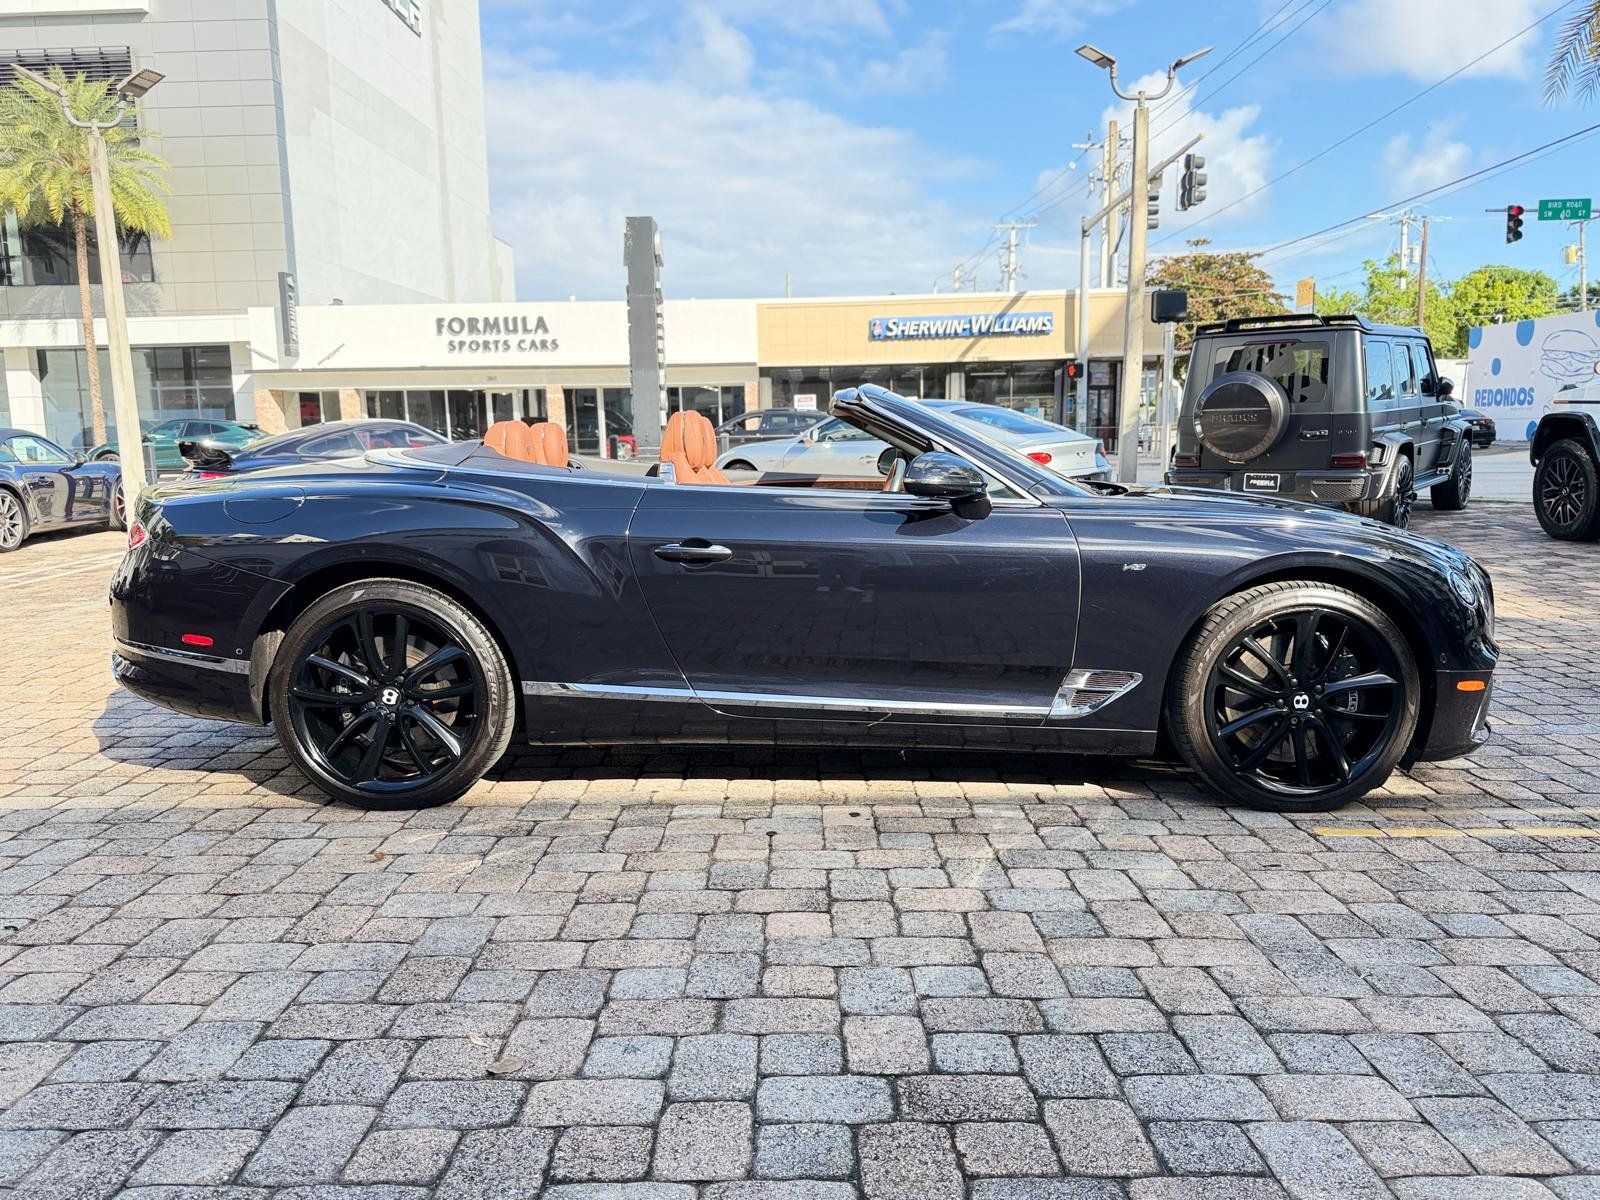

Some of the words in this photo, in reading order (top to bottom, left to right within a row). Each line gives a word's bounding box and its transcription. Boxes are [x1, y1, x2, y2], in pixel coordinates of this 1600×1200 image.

[1566, 200, 1583, 208] ROAD
[1578, 209, 1586, 217] ST
[435, 315, 549, 336] FORMULA
[886, 315, 1052, 337] SHERWIN-WILLIAMS
[448, 339, 511, 353] SPORTS
[517, 338, 559, 353] CARS
[1474, 386, 1535, 407] REDONDOS
[1203, 620, 1236, 662] ZERO
[485, 662, 498, 706] ZERO
